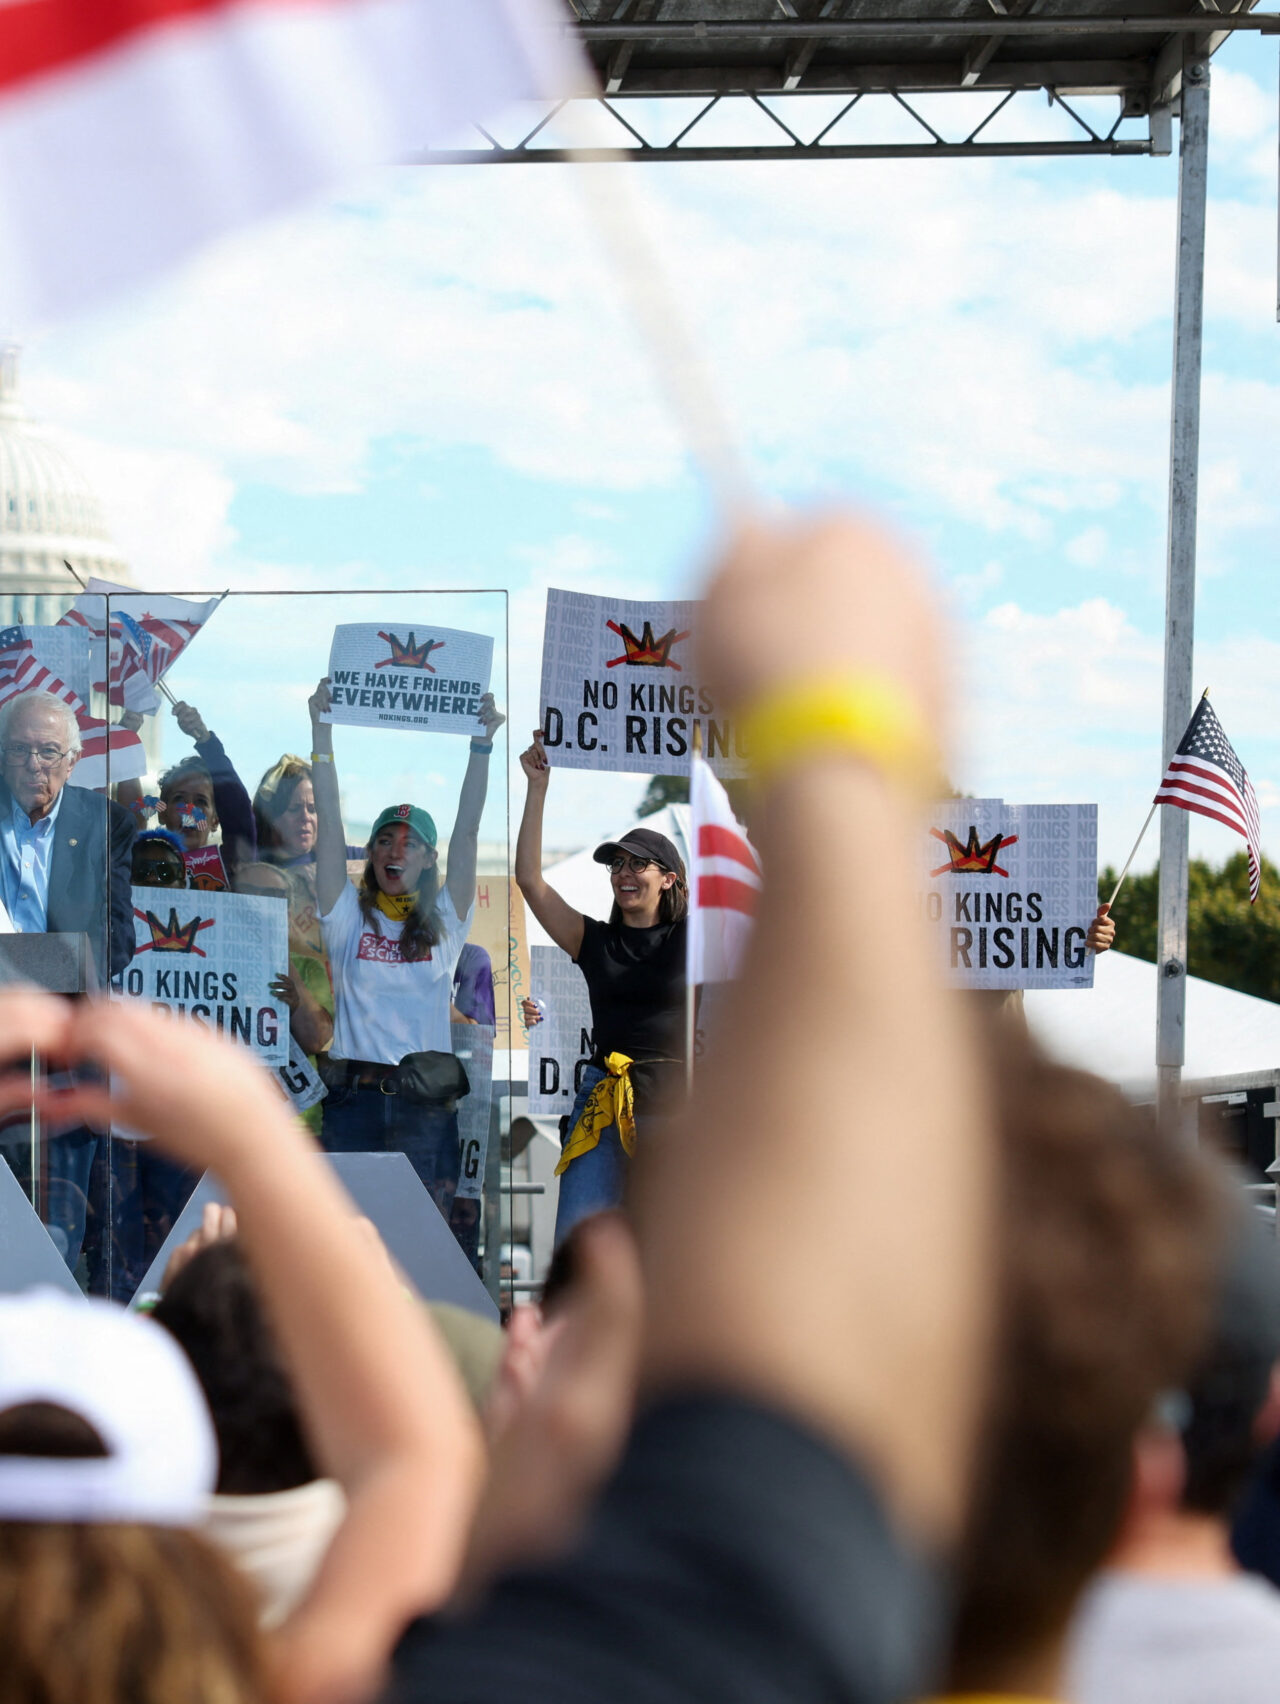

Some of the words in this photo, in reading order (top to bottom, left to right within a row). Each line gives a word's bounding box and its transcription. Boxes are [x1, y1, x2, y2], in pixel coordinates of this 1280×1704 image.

[334, 671, 360, 685] WE
[365, 672, 409, 689] HAVE
[413, 676, 481, 695] FRIENDS
[331, 687, 481, 716] EVERYWHERE
[584, 680, 618, 710] NO
[631, 684, 714, 715] KINGS
[379, 714, 428, 724] NOKINGS.ORG
[543, 707, 608, 751] D.C.
[1027, 805, 1070, 819] KINGS
[1077, 805, 1097, 819] NO
[1027, 822, 1070, 839] KINGS
[1077, 822, 1097, 839] NO
[1027, 841, 1070, 859] KINGS
[1077, 841, 1097, 858] NO
[1027, 861, 1070, 878] KINGS
[956, 893, 1042, 923] KINGS
[950, 927, 1086, 968] RISING
[156, 970, 237, 1001] KINGS
